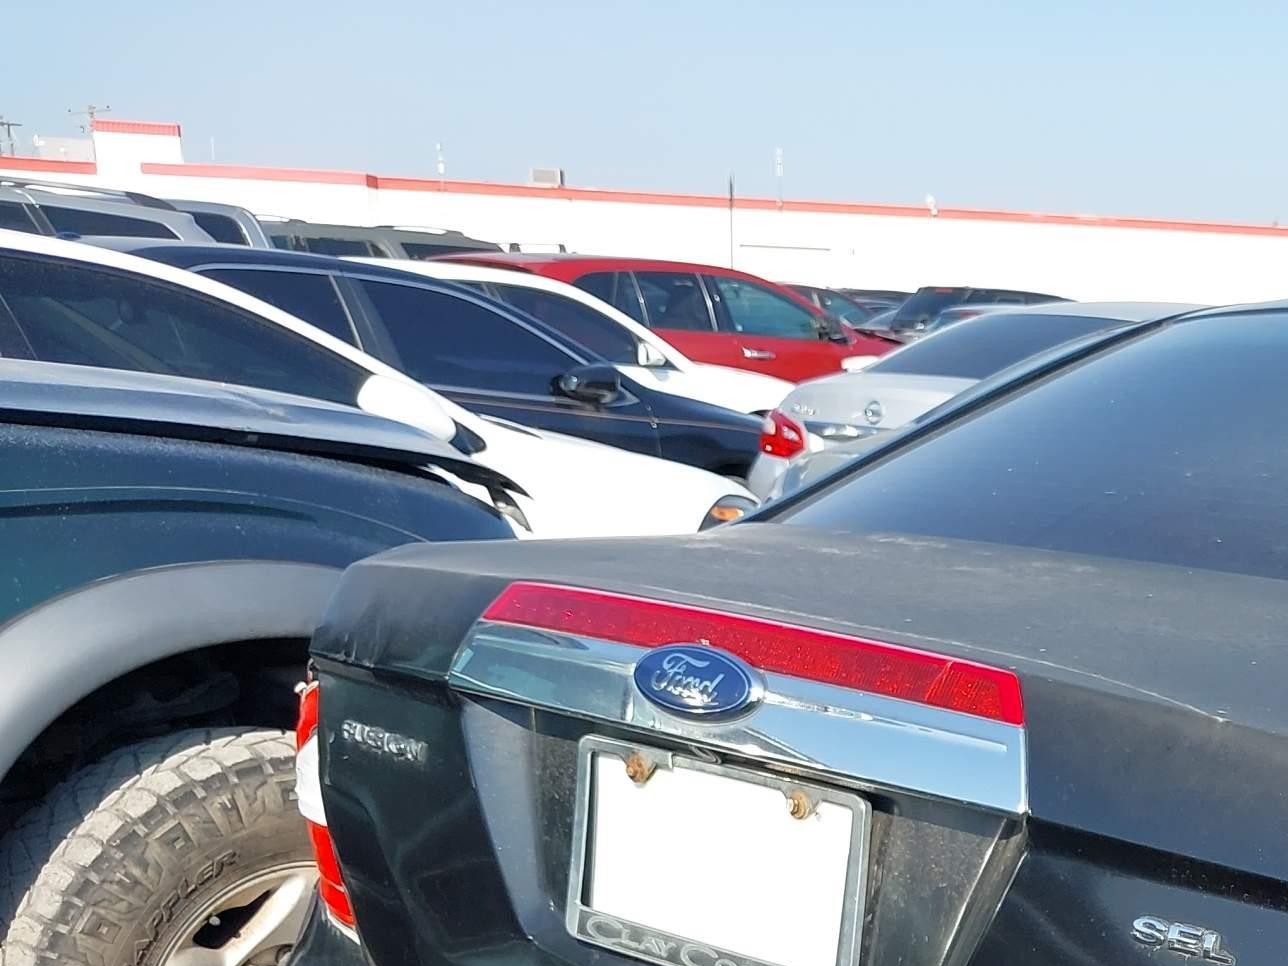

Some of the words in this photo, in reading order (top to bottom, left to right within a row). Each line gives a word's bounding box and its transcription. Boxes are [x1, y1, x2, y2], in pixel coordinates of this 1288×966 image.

[651, 652, 724, 706] Ford
[342, 719, 429, 764] FUSION
[586, 914, 676, 958] CLAY
